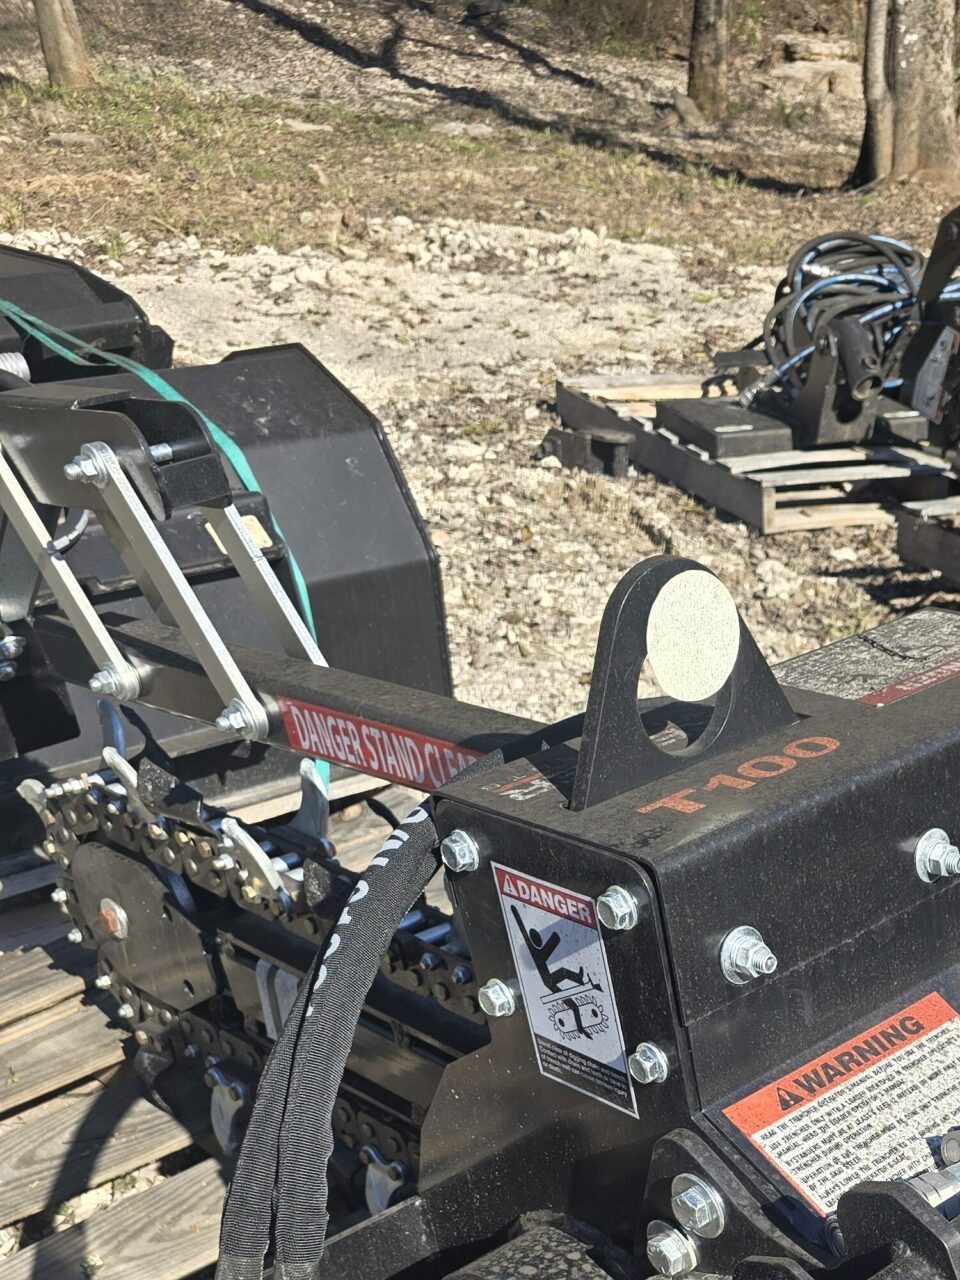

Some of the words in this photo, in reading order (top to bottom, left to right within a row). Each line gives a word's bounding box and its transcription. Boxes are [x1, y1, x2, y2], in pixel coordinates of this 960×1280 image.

[290, 704, 367, 767] DANGER
[361, 725, 425, 783] STAND
[423, 742, 477, 789] CLE
[516, 879, 593, 924] DANGER
[793, 1016, 925, 1096] WARNING
[760, 1129, 776, 1140] READ
[776, 1121, 789, 1130] THE
[788, 1104, 818, 1124] TRENCHER
[768, 1140, 781, 1149] USE
[781, 1123, 811, 1142] TRENCHER
[810, 1115, 825, 1126] ONLY
[825, 1106, 840, 1117] WITH
[845, 1090, 867, 1105] LOADER
[785, 1143, 822, 1166] BYSTANDERS
[821, 1133, 838, 1145] MUST
[854, 1111, 874, 1125] LEAST
[926, 1069, 942, 1080] MORE
[801, 1130, 819, 1142] READ
[817, 1123, 830, 1132] THE
[830, 1110, 851, 1125] LOADER
[792, 1154, 822, 1173] TRENCHER
[821, 1141, 843, 1156] DURING
[801, 1162, 833, 1183] OPERATION
[832, 1156, 842, 1164] OF
[841, 1149, 853, 1158] THE
[852, 1132, 881, 1151] TRENCHER
[904, 1108, 920, 1120] DONE
[817, 1183, 841, 1200] ALWAYS
[839, 1171, 861, 1186] LOWER
[859, 1164, 873, 1174] THE
[870, 1146, 899, 1166] TRENCHER
[907, 1134, 918, 1143] THE
[906, 1158, 922, 1170] WITH
[808, 1182, 818, 1191] OF
[817, 1175, 830, 1185] THE
[828, 1166, 844, 1178] SKID
